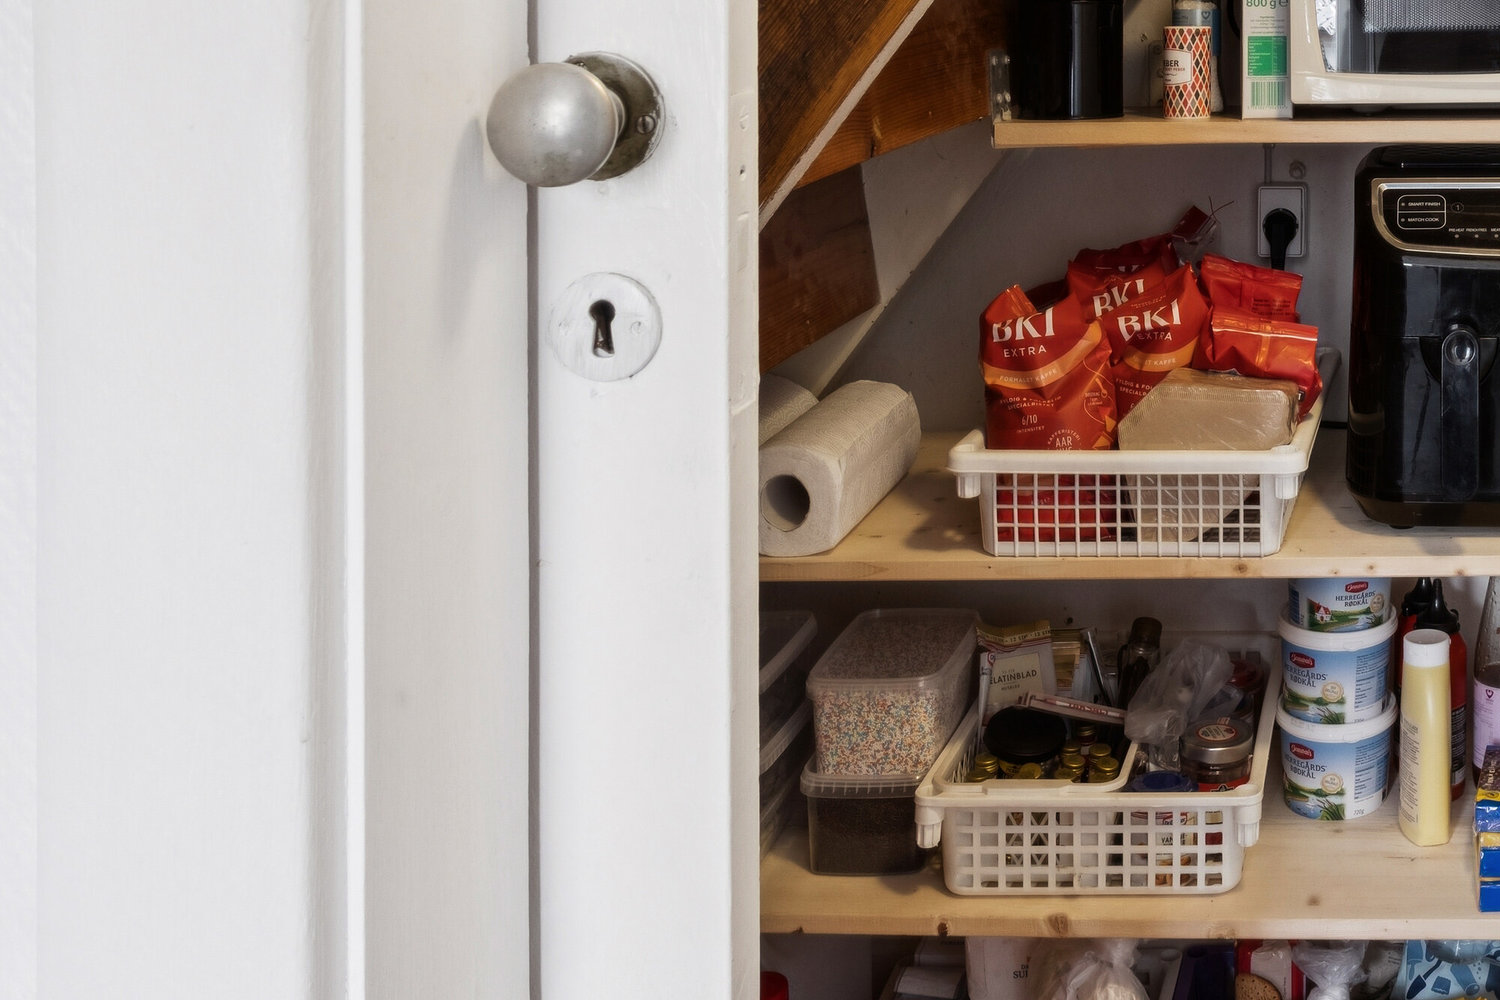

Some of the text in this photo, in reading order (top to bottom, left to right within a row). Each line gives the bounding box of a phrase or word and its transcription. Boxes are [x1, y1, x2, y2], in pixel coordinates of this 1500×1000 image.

[1269, 0, 1277, 10] g
[993, 306, 1055, 342] BKI
[1117, 298, 1181, 341] BKI
[1137, 331, 1172, 341] EXTRA
[1003, 344, 1047, 358] EXTRA
[1021, 414, 1038, 426] 6/10
[1335, 590, 1376, 602] HERREGÅRDS
[1344, 598, 1369, 608] RØDKÅL
[989, 669, 1038, 685] ELATINBLAD
